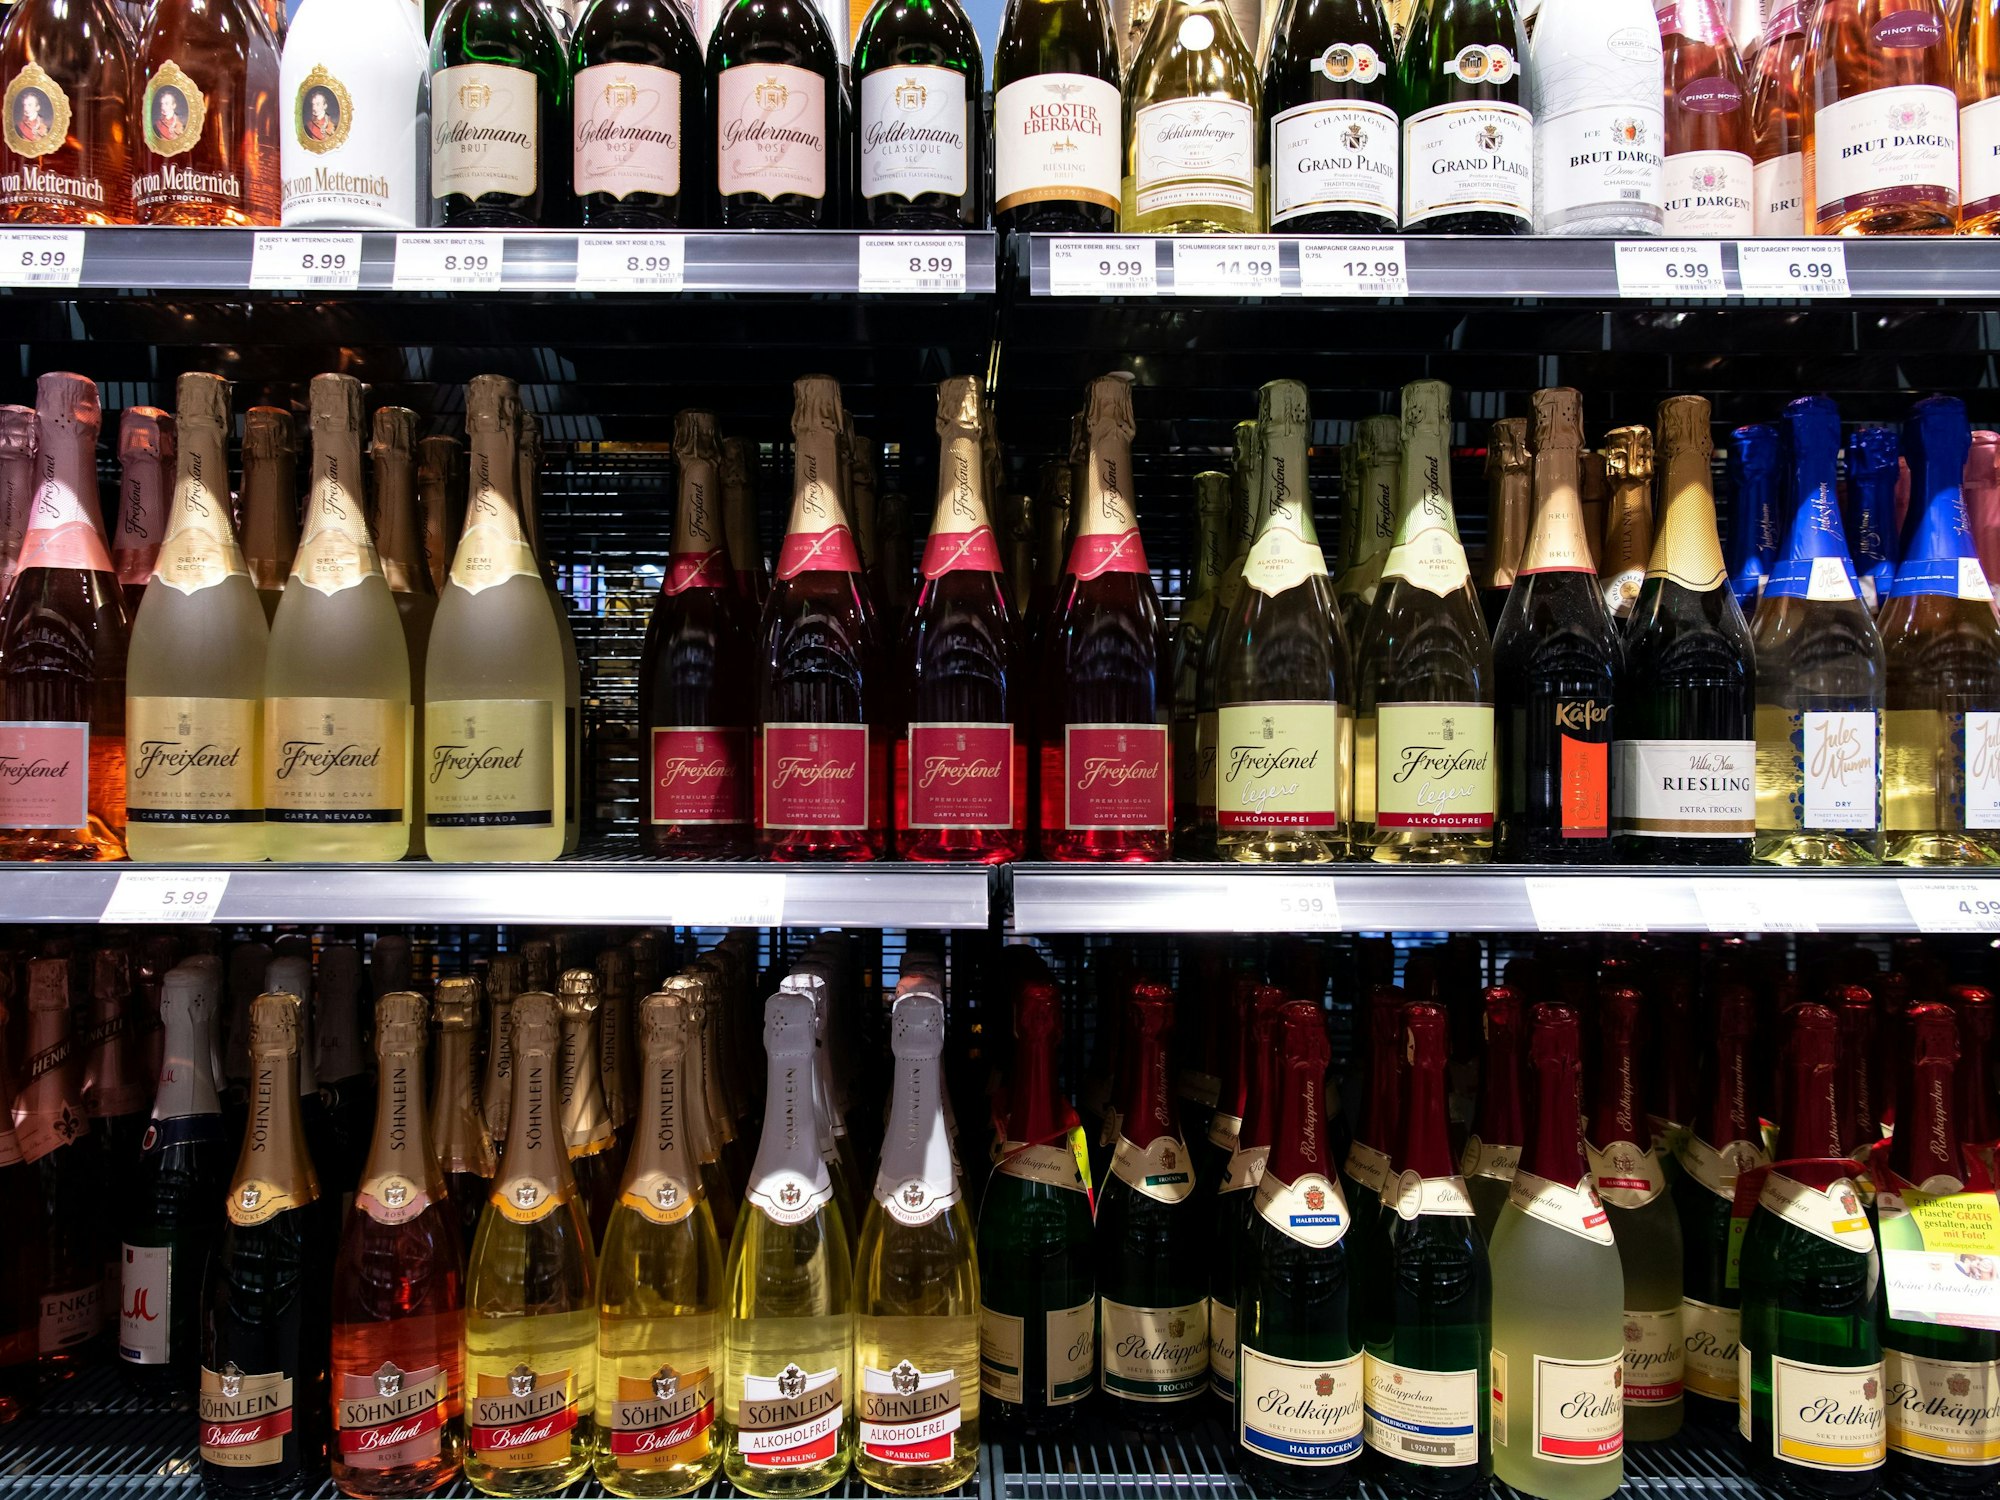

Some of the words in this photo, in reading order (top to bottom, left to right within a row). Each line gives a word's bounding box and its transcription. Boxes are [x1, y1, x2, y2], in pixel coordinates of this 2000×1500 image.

[1880, 26, 1912, 37] PINOT
[1030, 102, 1099, 120] KLOSTER
[1024, 118, 1102, 136] EBERBACH
[1313, 113, 1388, 133] CHAMPAGNE
[433, 119, 532, 153] Geldermann
[721, 119, 823, 152] Geldermann
[863, 120, 963, 154] Geldermann
[1157, 123, 1236, 144] Schlumberger
[461, 143, 488, 153] BRUT
[882, 144, 942, 155] CLASSIQUE
[1842, 138, 1888, 159] BRUT
[1894, 134, 1955, 151] DARGENT
[1042, 163, 1086, 173] RIESLING
[1298, 157, 1352, 173] GRAND
[1357, 155, 1394, 179] PLAISIR
[1570, 150, 1613, 168] BRUT
[2, 174, 21, 194] von
[23, 163, 104, 203] Metternich
[143, 173, 161, 194] von
[162, 164, 240, 199] Metternich
[294, 177, 312, 194] von
[314, 167, 389, 199] Metternich
[1324, 181, 1355, 189] TRADITION
[1899, 173, 1919, 182] 2017
[1623, 190, 1640, 199] 2018
[21, 251, 66, 267] 8.99
[301, 254, 346, 269] 8.99
[444, 255, 488, 271] 8.99
[627, 256, 670, 272] 8.99
[909, 257, 953, 272] 8.99
[1099, 261, 1142, 276] 9.99
[1216, 261, 1272, 276] 14.99
[1343, 262, 1400, 277] 12.99
[1665, 263, 1709, 278] 6.99
[1789, 263, 1832, 278] 6.99
[186, 451, 209, 518] Freixenet
[1269, 456, 1293, 520] Freixenet
[1423, 456, 1448, 521] Freixenet
[1624, 502, 1632, 523] NAU
[1623, 525, 1632, 561] VILLA
[1555, 699, 1616, 730] Käfer
[1810, 716, 1862, 778] Jules
[135, 741, 241, 779] Freixenet
[277, 741, 381, 779] Freixenet
[430, 745, 524, 784] Freixenet
[1225, 746, 1319, 782] Freixenet
[1393, 746, 1488, 783] Freixenet
[1689, 752, 1711, 771] Villa
[1712, 754, 1734, 771] Nau
[1821, 749, 1873, 790] Mumm
[772, 757, 857, 789] Freixenet
[919, 756, 1003, 788] Freixenet
[1078, 757, 1159, 790] Freixenet
[1662, 776, 1750, 791] RIESLING
[1241, 780, 1299, 814] legero
[1416, 781, 1475, 816] legero
[1234, 815, 1309, 823] ALKOHOLFREI
[1407, 816, 1483, 824] ALKOHOLFREI
[162, 891, 208, 905] 5.99
[1958, 900, 2000, 915] 4.99
[1617, 1056, 1632, 1132] Rotkäppchen
[252, 1069, 273, 1152] SÖHNLEIN
[660, 1068, 674, 1151] SÖHNLEIN
[1300, 1080, 1316, 1163] Rotkäppchen
[1930, 1080, 1949, 1162] Rotkäppchen
[233, 1209, 266, 1221] TROCKEN
[516, 1210, 538, 1219] MILD
[891, 1206, 937, 1222] ALKOHOLFREI
[1924, 1199, 1964, 1209] Etiketten
[1967, 1202, 1983, 1212] pro
[1924, 1219, 1968, 1229] gestalten,
[1970, 1221, 1993, 1230] auch
[1956, 1211, 1992, 1221] GRATIS
[1943, 1230, 1959, 1238] mit
[1961, 1231, 1986, 1240] Foto!
[1158, 1381, 1194, 1392] TROCKEN
[1370, 1376, 1433, 1402] Rotkäppchen
[201, 1392, 278, 1418] SÖHNLEIN
[346, 1384, 437, 1424] SÖHNLEIN
[480, 1389, 569, 1422] SÖHNLEIN
[748, 1387, 835, 1425] SÖHNLEIN
[866, 1389, 950, 1417] SÖHNLEIN
[753, 1418, 831, 1449] ALKOHOLFREI
[870, 1419, 945, 1440] ALKOHOLFREI
[1269, 1423, 1287, 1432] SEKT
[1289, 1427, 1326, 1436] FEINSTER
[1380, 1415, 1420, 1432] HALBTROCKEN
[206, 1426, 261, 1446] Brillant
[358, 1420, 423, 1450] Brillant
[490, 1422, 552, 1449] Brillant
[212, 1451, 252, 1461] TROCKEN
[509, 1453, 533, 1461] MILD
[771, 1452, 817, 1463] SPARKLING
[884, 1449, 930, 1459] SPARKLING
[1289, 1441, 1353, 1455] HALBTROCKEN
[1946, 1444, 1973, 1455] MILD
